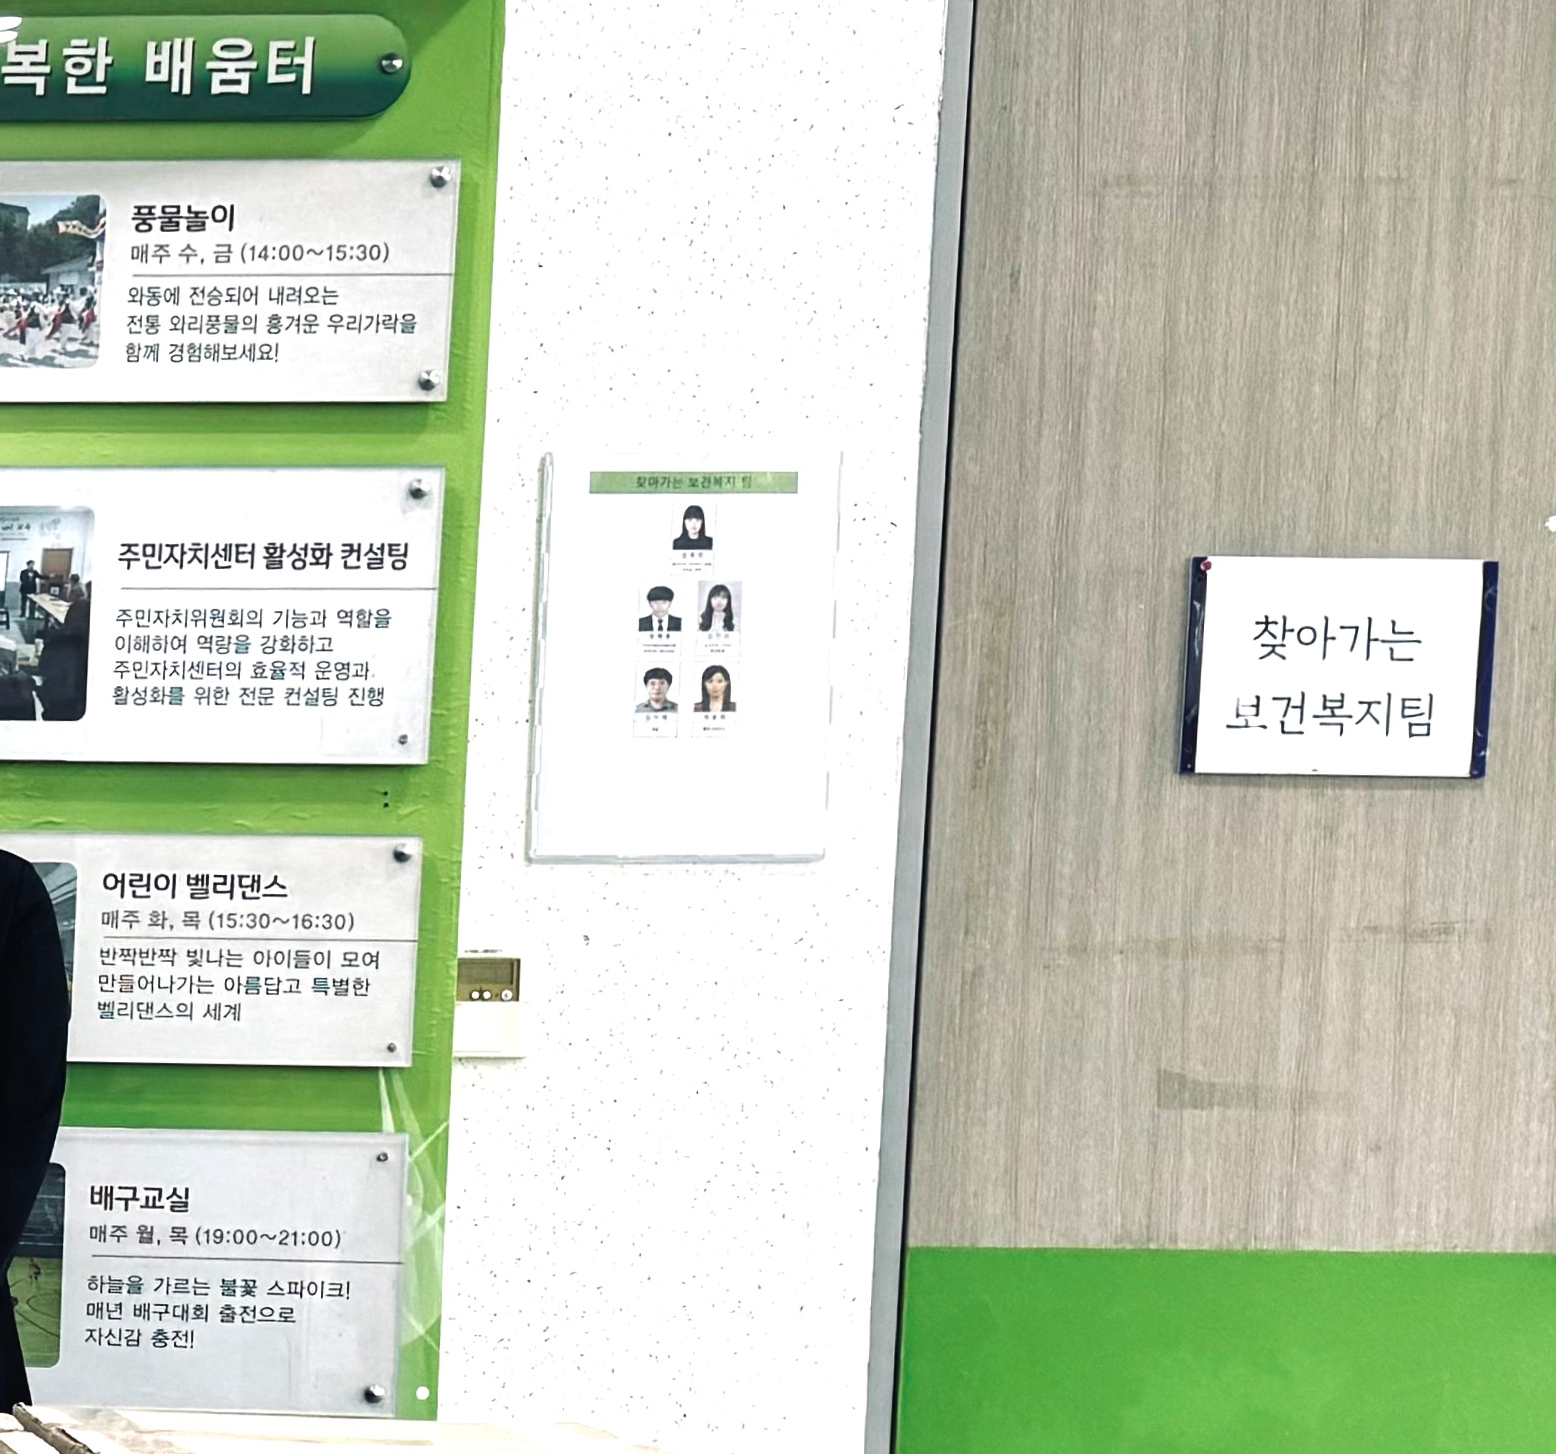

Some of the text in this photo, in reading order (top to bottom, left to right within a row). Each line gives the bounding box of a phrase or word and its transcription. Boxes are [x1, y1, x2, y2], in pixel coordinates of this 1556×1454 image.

[145, 36, 317, 96] 배움터
[131, 204, 235, 233] 풍물놀이
[131, 244, 171, 264] 매주
[178, 244, 205, 264] 수,
[213, 244, 233, 264] 금
[128, 286, 339, 306] 와동에 전승되어 내려오는
[126, 314, 417, 334] 전통 와리풍물의 흥겨운 우리가락을
[126, 342, 279, 362] 함께 경험해보세요!
[637, 476, 684, 489] 찾아가는
[117, 542, 409, 571] 주민자치센터 활성화 컨설팅
[115, 608, 392, 629] 주민자치위원회의 기능과 역할을
[115, 634, 334, 654] 이해하여 역량을 강화하고
[1254, 615, 1422, 662] 찾아가는
[113, 661, 369, 680] 주민자치센터의 효율적 운영과
[112, 686, 384, 707] 활성화를 위한 전문 컨설팅 진행
[1226, 692, 1434, 738] 보건복지팀
[103, 873, 288, 900] 어린이 벨리댄스
[101, 910, 140, 930] 매주
[147, 910, 174, 930] 화,
[182, 910, 201, 930] 목
[99, 948, 380, 970] 반짝반짝 빛나는 아이들이 모여
[98, 974, 370, 997] 만들어나가는 아름답고 특별한
[97, 1001, 241, 1021] 벨리댄스의 세계
[90, 1185, 190, 1212] 배구교실
[89, 1225, 128, 1244] 매주
[137, 1225, 160, 1245] 월,
[169, 1226, 188, 1245] 목
[87, 1275, 351, 1300] 하늘을 가르는 불꽃 스파이크!
[87, 1302, 296, 1324] 매년 배구대회 출전으로
[85, 1328, 194, 1348] 자신감 충전!
